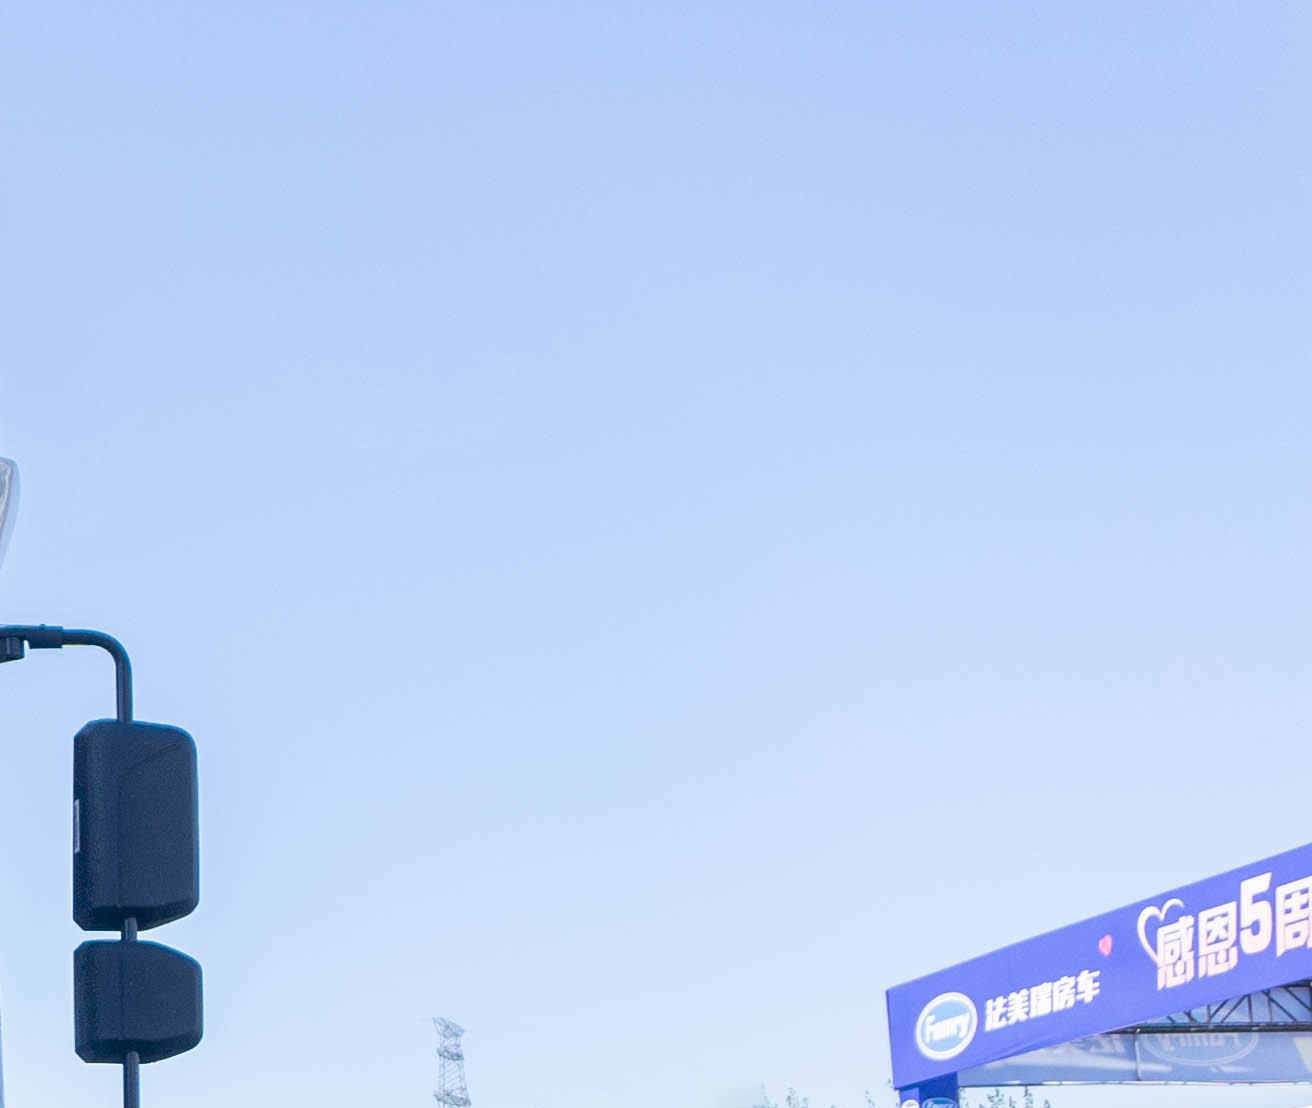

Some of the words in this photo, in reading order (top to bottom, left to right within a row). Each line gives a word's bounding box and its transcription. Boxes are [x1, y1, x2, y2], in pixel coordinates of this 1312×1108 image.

[1157, 872, 1312, 991] 感恩5周
[984, 969, 1102, 1032] 法美瑞房车
